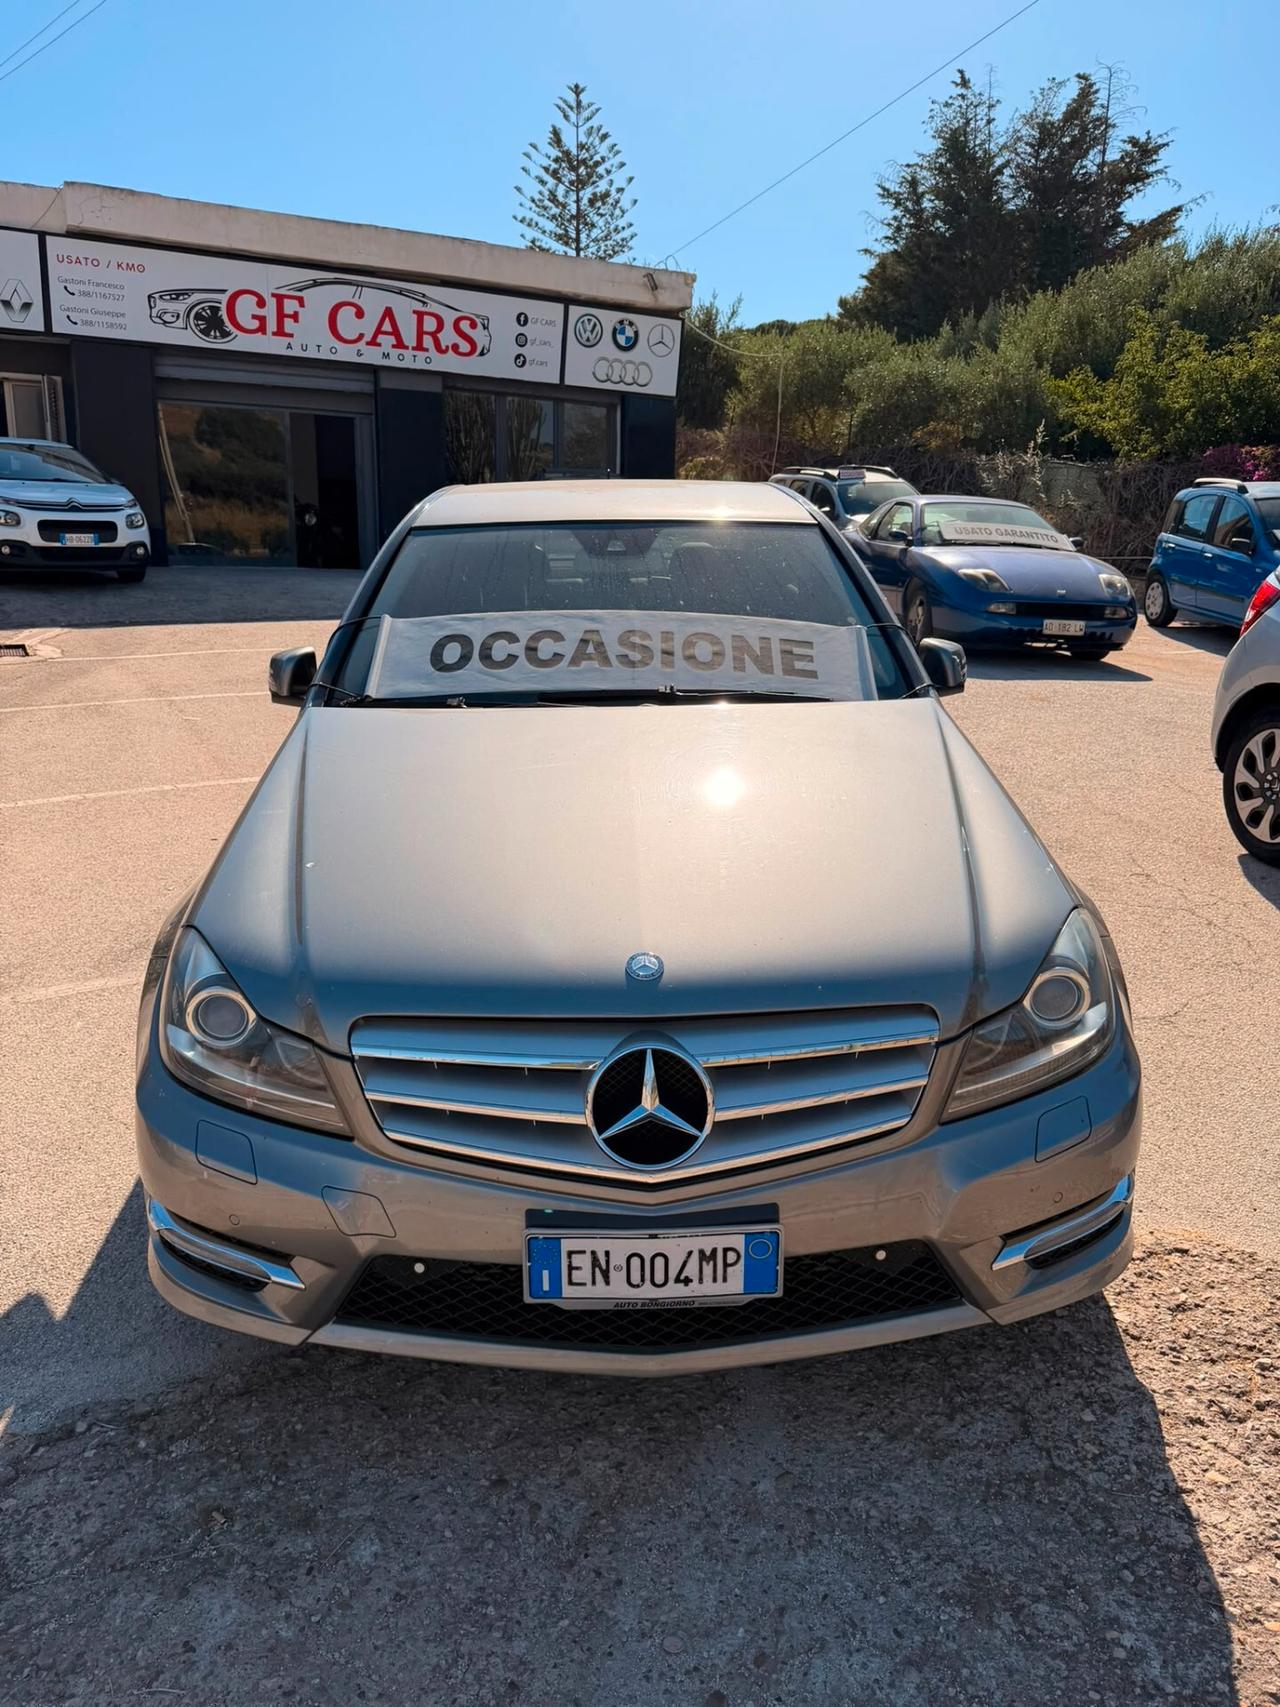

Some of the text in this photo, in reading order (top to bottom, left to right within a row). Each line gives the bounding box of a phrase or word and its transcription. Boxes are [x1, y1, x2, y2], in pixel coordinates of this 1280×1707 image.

[56, 253, 100, 267] USATO
[106, 260, 112, 270] /
[57, 275, 125, 290] Gastoni Francesco
[59, 304, 127, 319] Gastoni Giuseppe
[225, 287, 479, 358] GF CARS
[530, 316, 557, 328] GF CARS
[286, 342, 433, 365] AUTO & MOTO
[954, 525, 1059, 543] USATO GARANTITO
[429, 628, 819, 680] OCCASIONE
[566, 1249, 611, 1288] EN
[613, 1301, 638, 1309] AUTO
[640, 1300, 695, 1309] BONGIORNO
